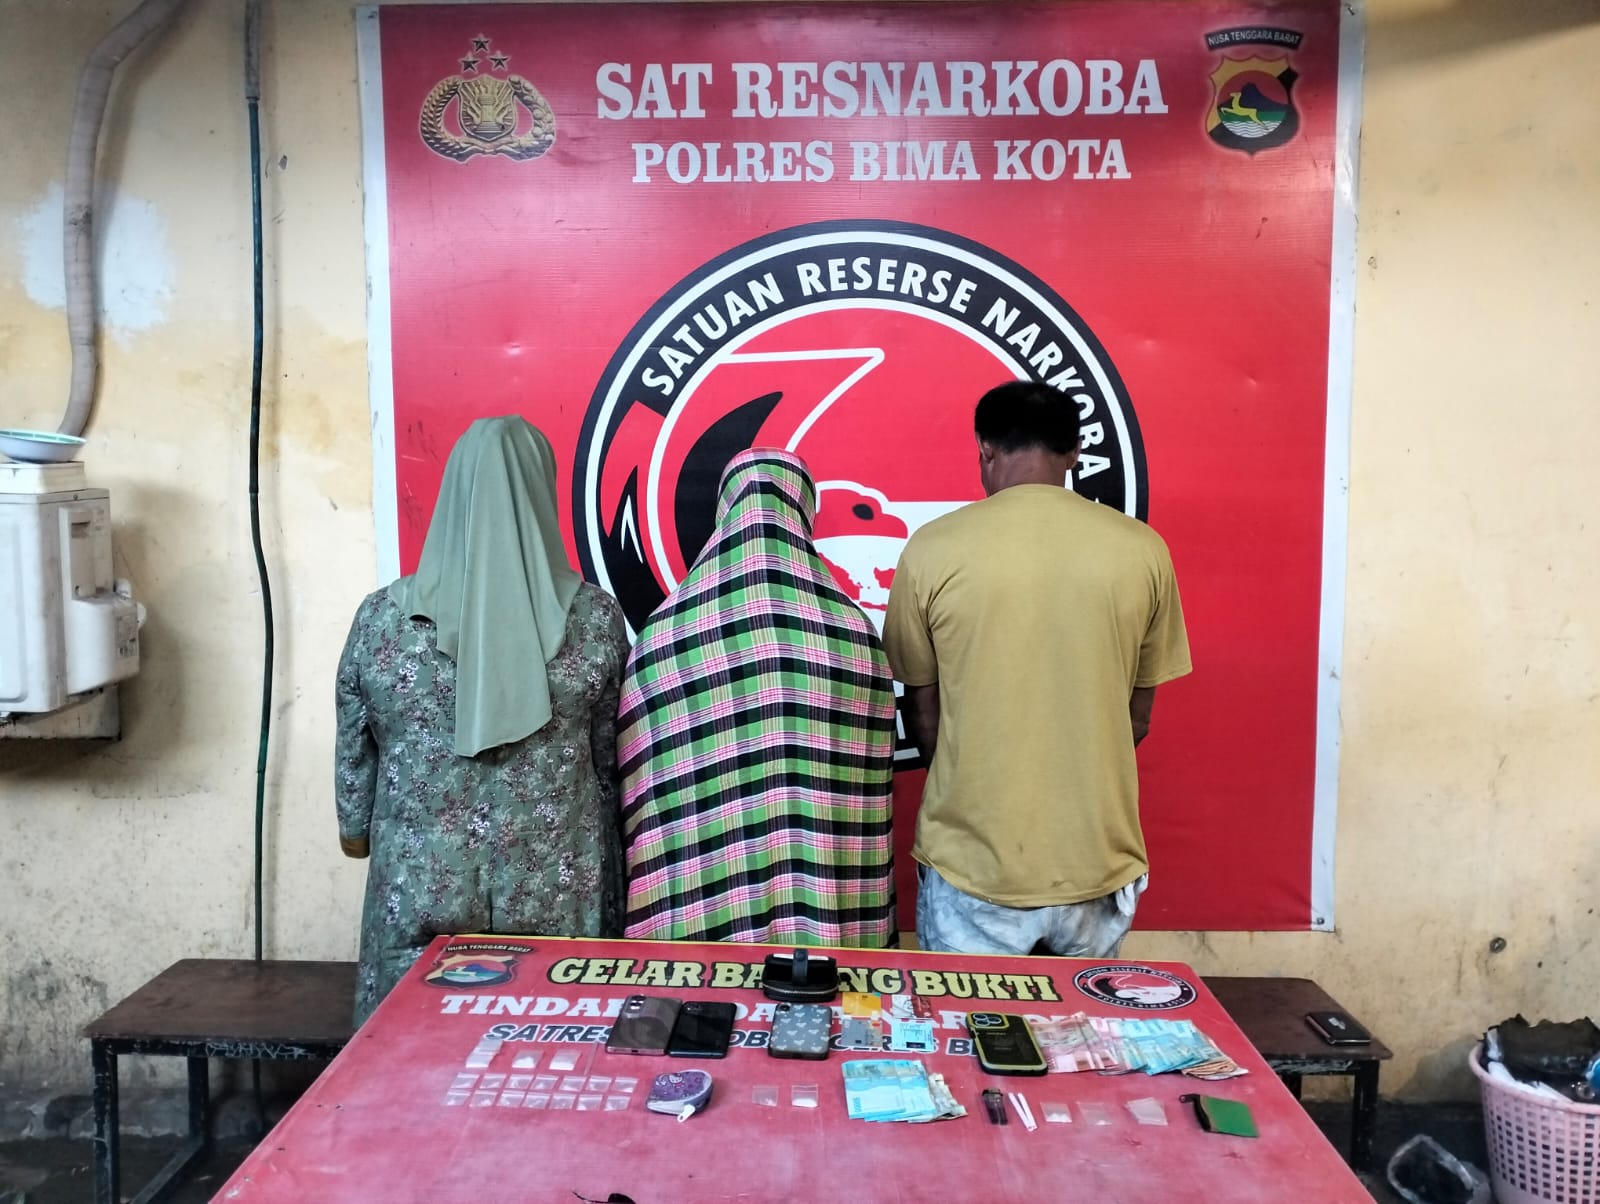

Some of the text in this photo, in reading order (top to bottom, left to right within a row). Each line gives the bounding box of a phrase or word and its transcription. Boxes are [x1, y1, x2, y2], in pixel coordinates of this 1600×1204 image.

[1208, 30, 1300, 46] NUSA TENGGARA BARAT
[596, 59, 1169, 120] SAT RESNARKOBA
[632, 138, 1131, 184] POLRES BIMA KOTA
[641, 272, 785, 396] SATUAN
[796, 256, 978, 314] RESERSE
[548, 956, 1063, 1002] GELAR BANG BUKTI
